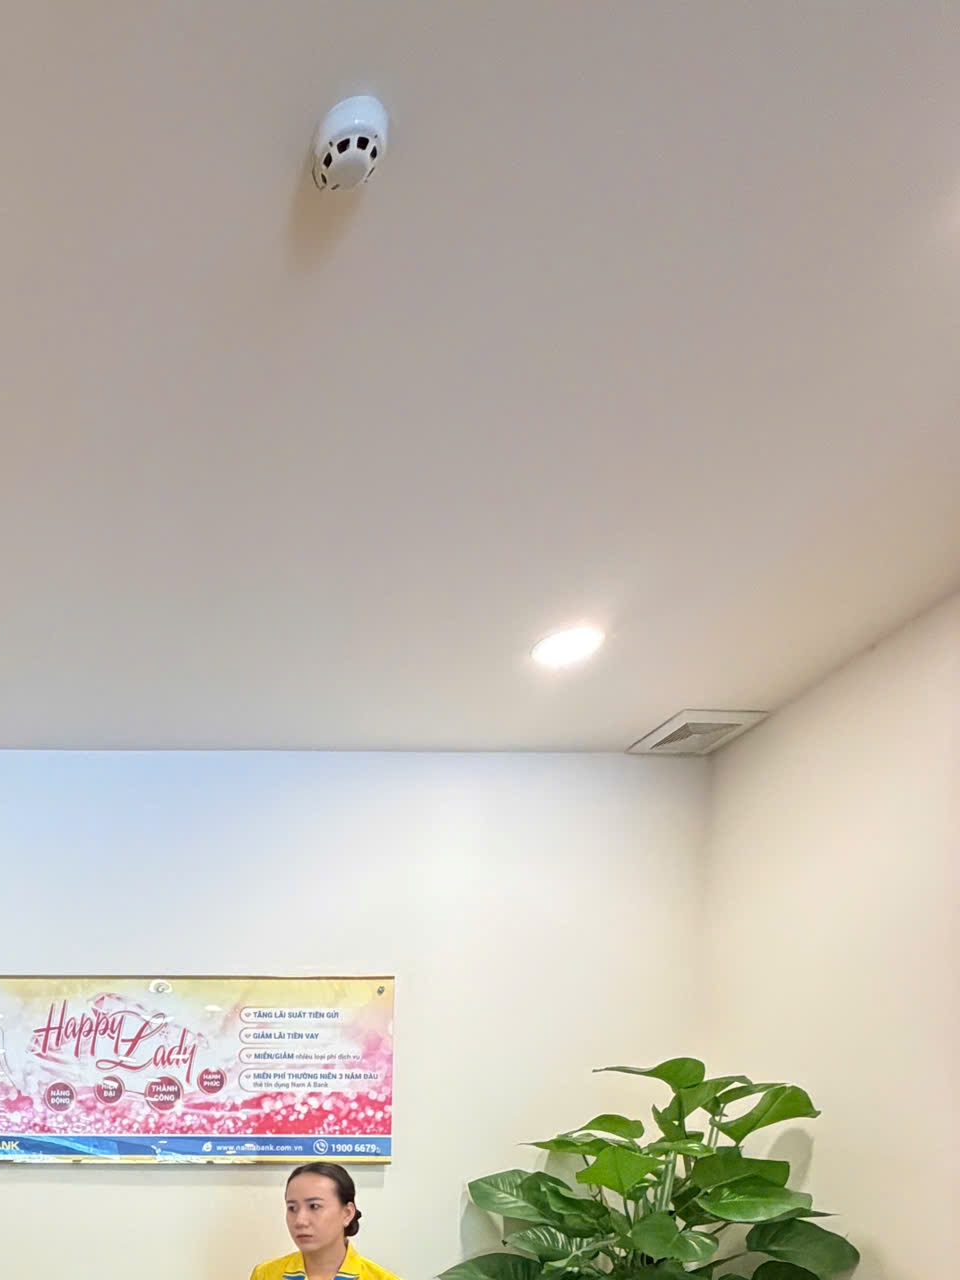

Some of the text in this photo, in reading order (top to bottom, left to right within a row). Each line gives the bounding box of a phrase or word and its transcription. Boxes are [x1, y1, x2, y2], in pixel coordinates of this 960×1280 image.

[253, 1010, 273, 1018] TĂNG
[274, 1010, 286, 1018] LÃI
[288, 1010, 307, 1018] SUẤT
[33, 1000, 124, 1058] Happy
[252, 1031, 272, 1039] GIẢM
[274, 1031, 285, 1039] LÃI
[96, 1011, 196, 1084] Lady
[273, 1072, 286, 1080] PHÍ
[288, 1072, 318, 1080] THƯỜNG
[345, 1072, 361, 1080] NĂM
[151, 1084, 178, 1092] THÀNH
[50, 1088, 70, 1097] NĂNG
[154, 1093, 175, 1101] CÔNG
[331, 1143, 376, 1152] 1900 6679
